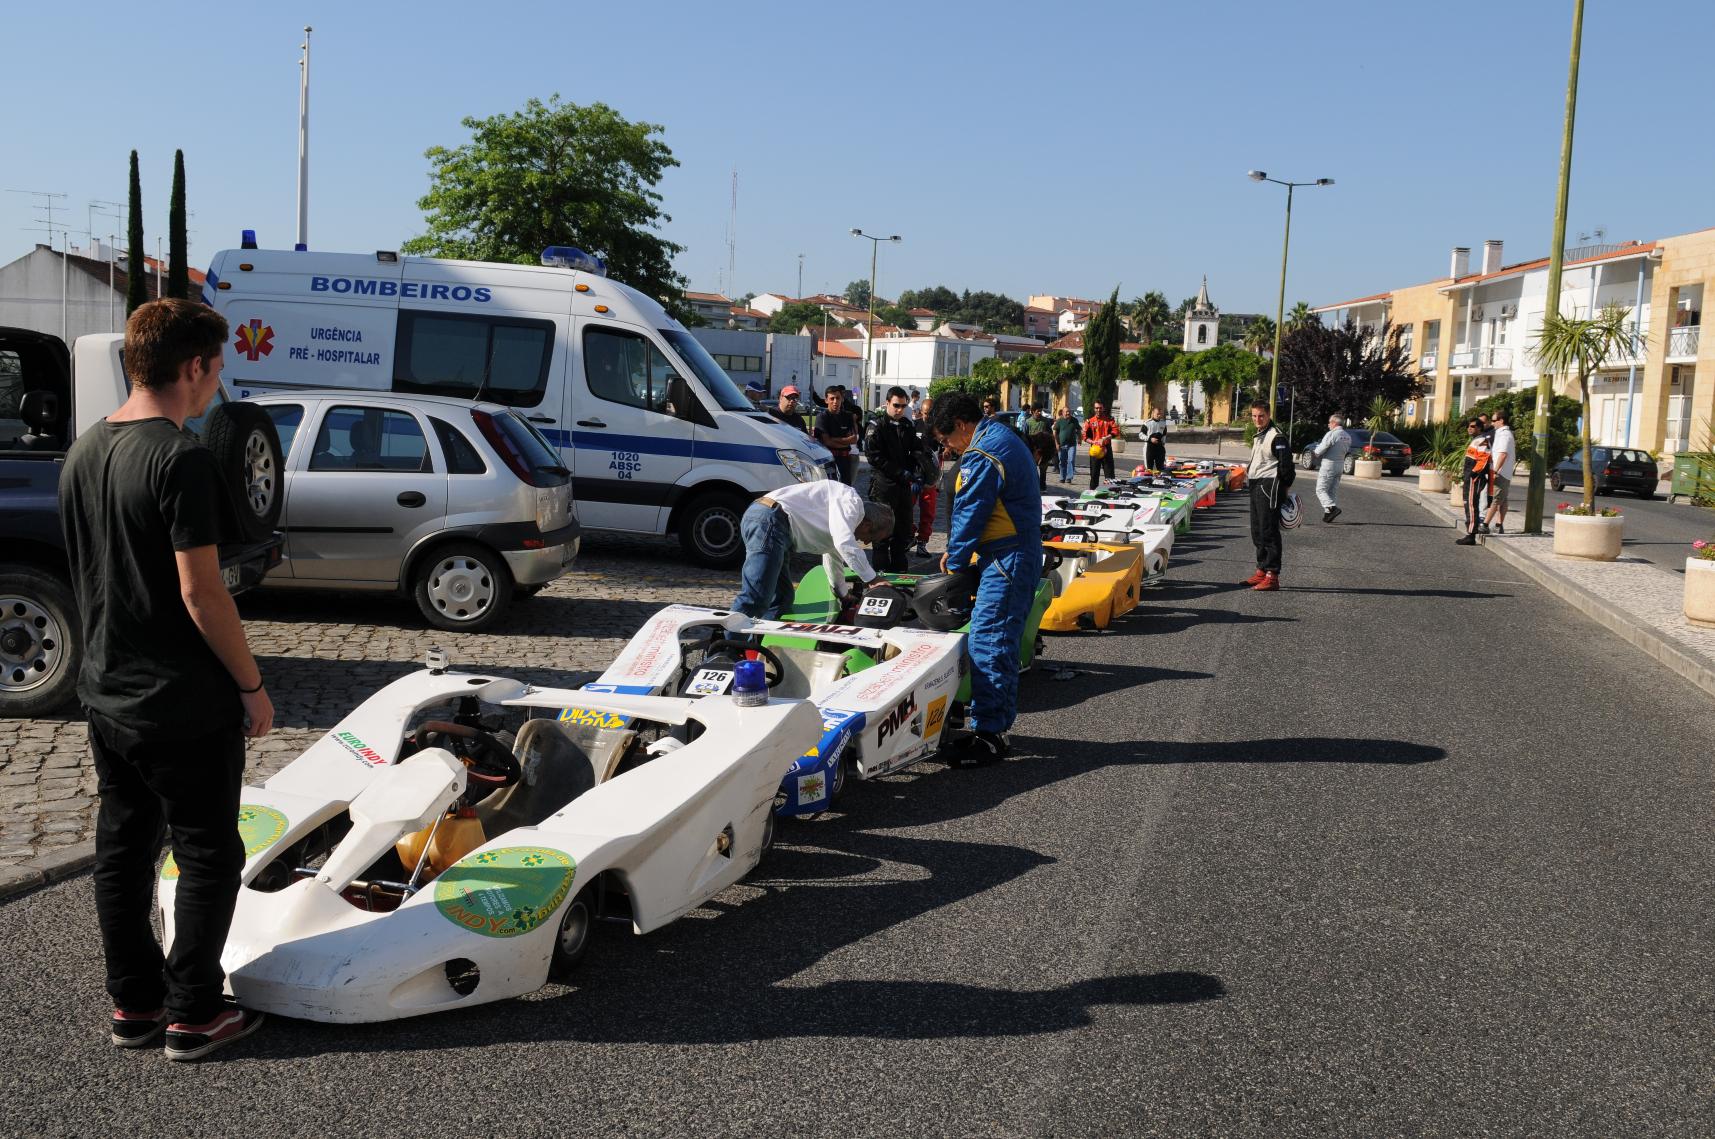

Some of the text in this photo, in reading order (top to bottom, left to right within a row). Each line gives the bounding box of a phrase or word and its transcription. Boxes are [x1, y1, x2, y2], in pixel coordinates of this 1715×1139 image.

[311, 277, 492, 303] BOMBEIROS
[311, 327, 363, 343] URGÊNCIA
[317, 349, 380, 365] HOSPITALAR
[612, 452, 639, 461] 1020
[609, 461, 642, 472] ABSC
[618, 471, 632, 480] 04
[867, 598, 888, 607] 89
[702, 671, 728, 682] 126
[926, 704, 945, 729] 126
